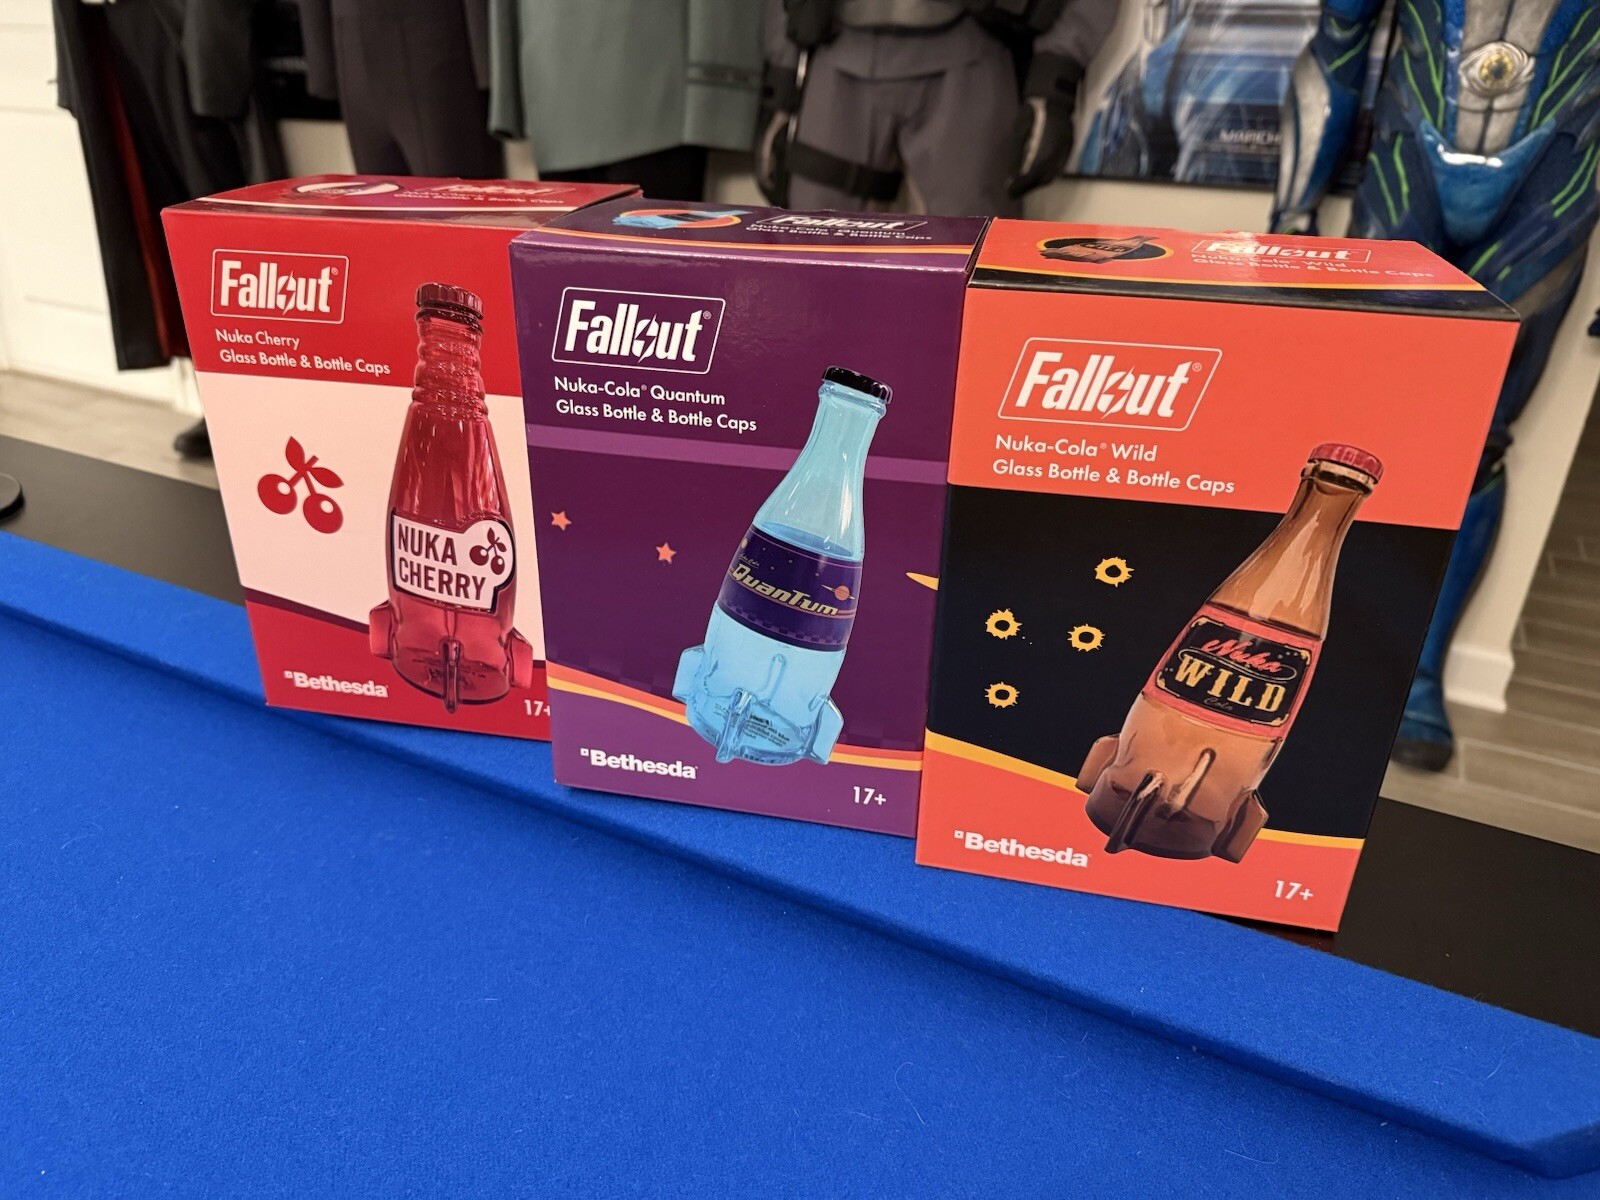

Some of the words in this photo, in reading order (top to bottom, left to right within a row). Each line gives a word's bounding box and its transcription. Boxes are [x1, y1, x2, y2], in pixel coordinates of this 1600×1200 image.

[771, 216, 906, 229] Fallout
[1205, 242, 1350, 260] Fallout
[1326, 267, 1381, 275] Bottle
[220, 259, 333, 316] Fallout
[215, 328, 253, 345] Nuka
[255, 330, 300, 350] Cherry
[564, 299, 704, 363] Fallout
[219, 349, 257, 365] Glass
[258, 351, 297, 368] Bottle
[300, 354, 312, 369] &
[313, 355, 353, 372] Bottle
[355, 359, 391, 377] Caps
[650, 385, 726, 405] Quantum
[1015, 350, 1193, 420] Fallout
[556, 399, 600, 417] Glass
[602, 403, 647, 421] Bottle
[651, 407, 664, 423] &
[668, 409, 713, 428] Bottle
[716, 414, 757, 434] Caps
[1111, 443, 1158, 462] Wild
[992, 458, 1043, 478] Glass
[1048, 462, 1101, 483] Bottle
[1105, 467, 1121, 484] &
[1126, 468, 1181, 489] Bottle
[1186, 474, 1236, 496] Caps
[398, 523, 458, 567] NUKA
[399, 556, 487, 601] CHERRY
[1201, 639, 1282, 673] Nuka
[293, 671, 389, 698] Bethesda
[1174, 653, 1287, 713] WILD
[589, 748, 697, 780] Bethesda
[853, 785, 887, 806] 17+
[964, 831, 1089, 869] Bethesda
[1273, 879, 1315, 902] 17+
